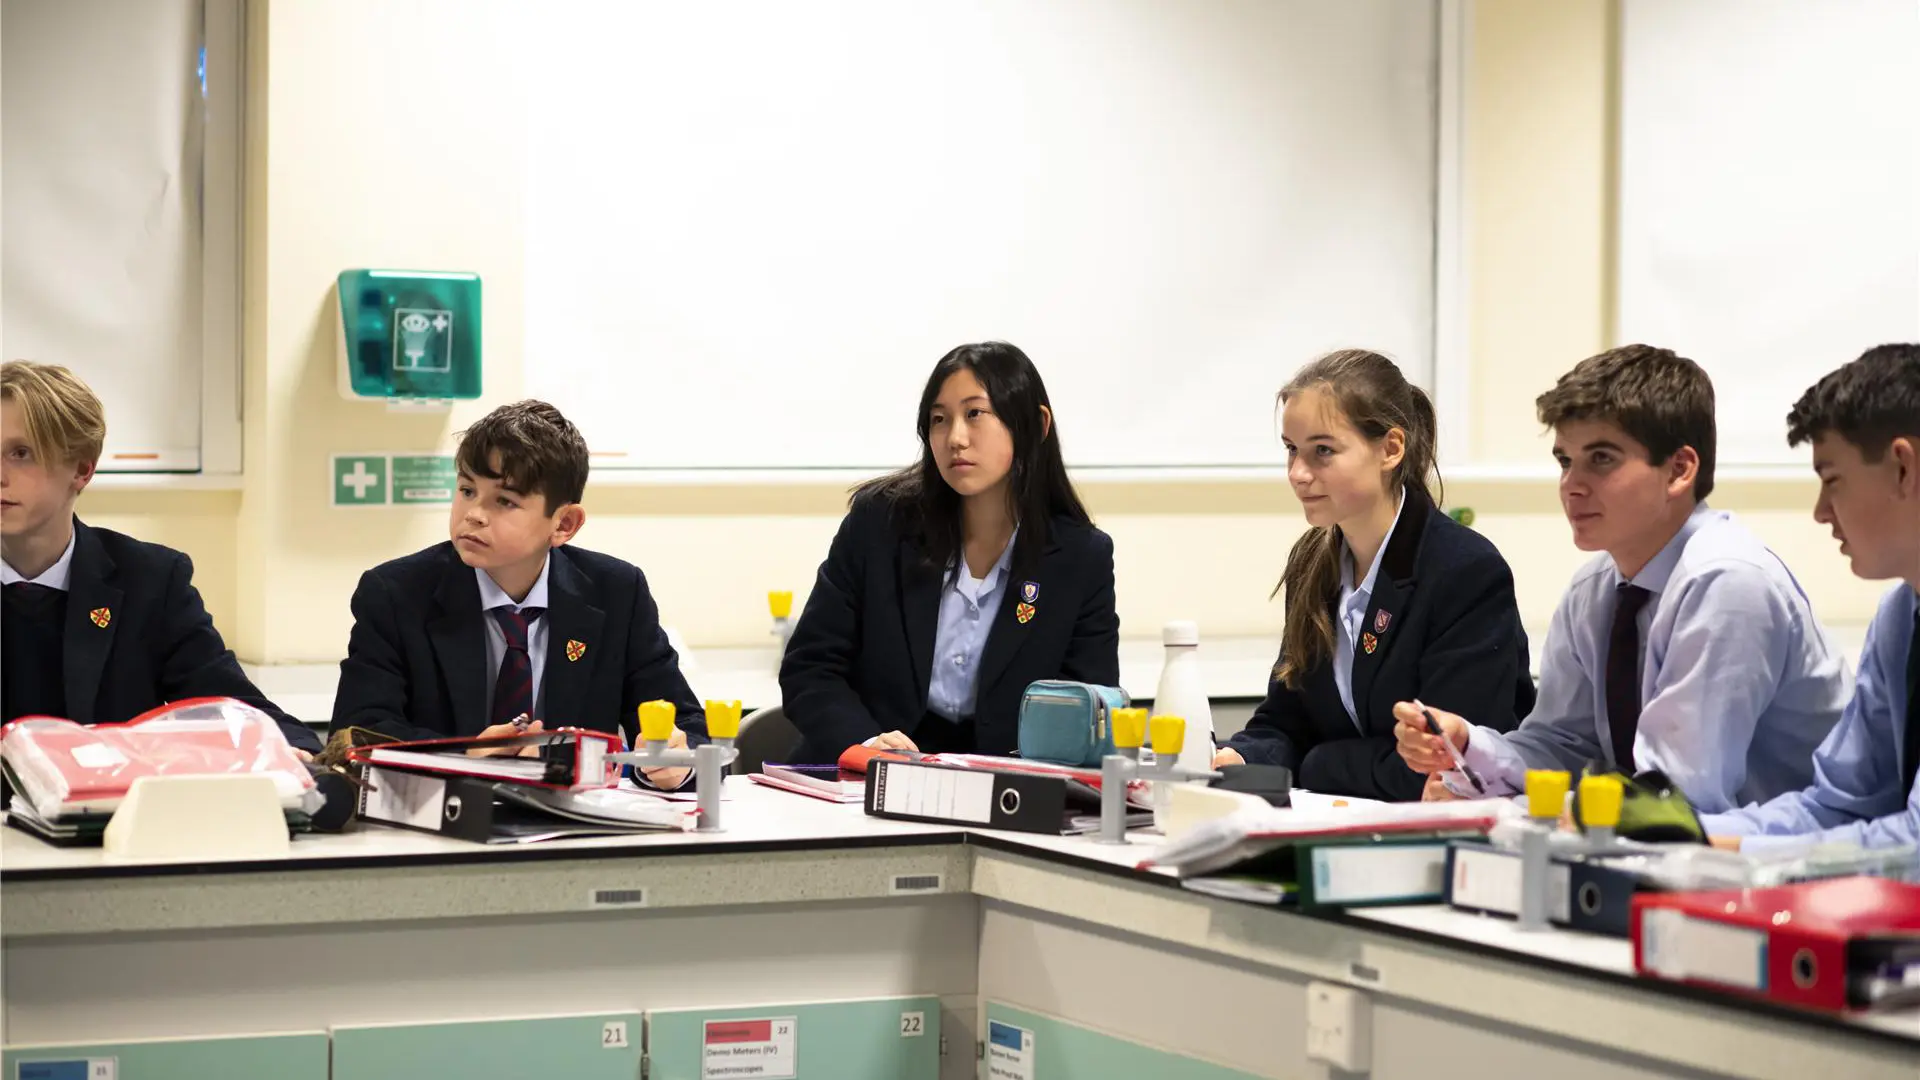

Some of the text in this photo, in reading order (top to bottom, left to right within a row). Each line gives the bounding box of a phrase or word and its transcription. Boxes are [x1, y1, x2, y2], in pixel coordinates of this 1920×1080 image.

[878, 765, 886, 810] EASTLIGHT
[778, 1026, 788, 1035] 22
[902, 1017, 921, 1032] 22
[604, 1028, 622, 1044] 21
[706, 1048, 731, 1056] Demo
[733, 1047, 762, 1055] Meters
[706, 1065, 764, 1076] Spectroscopes
